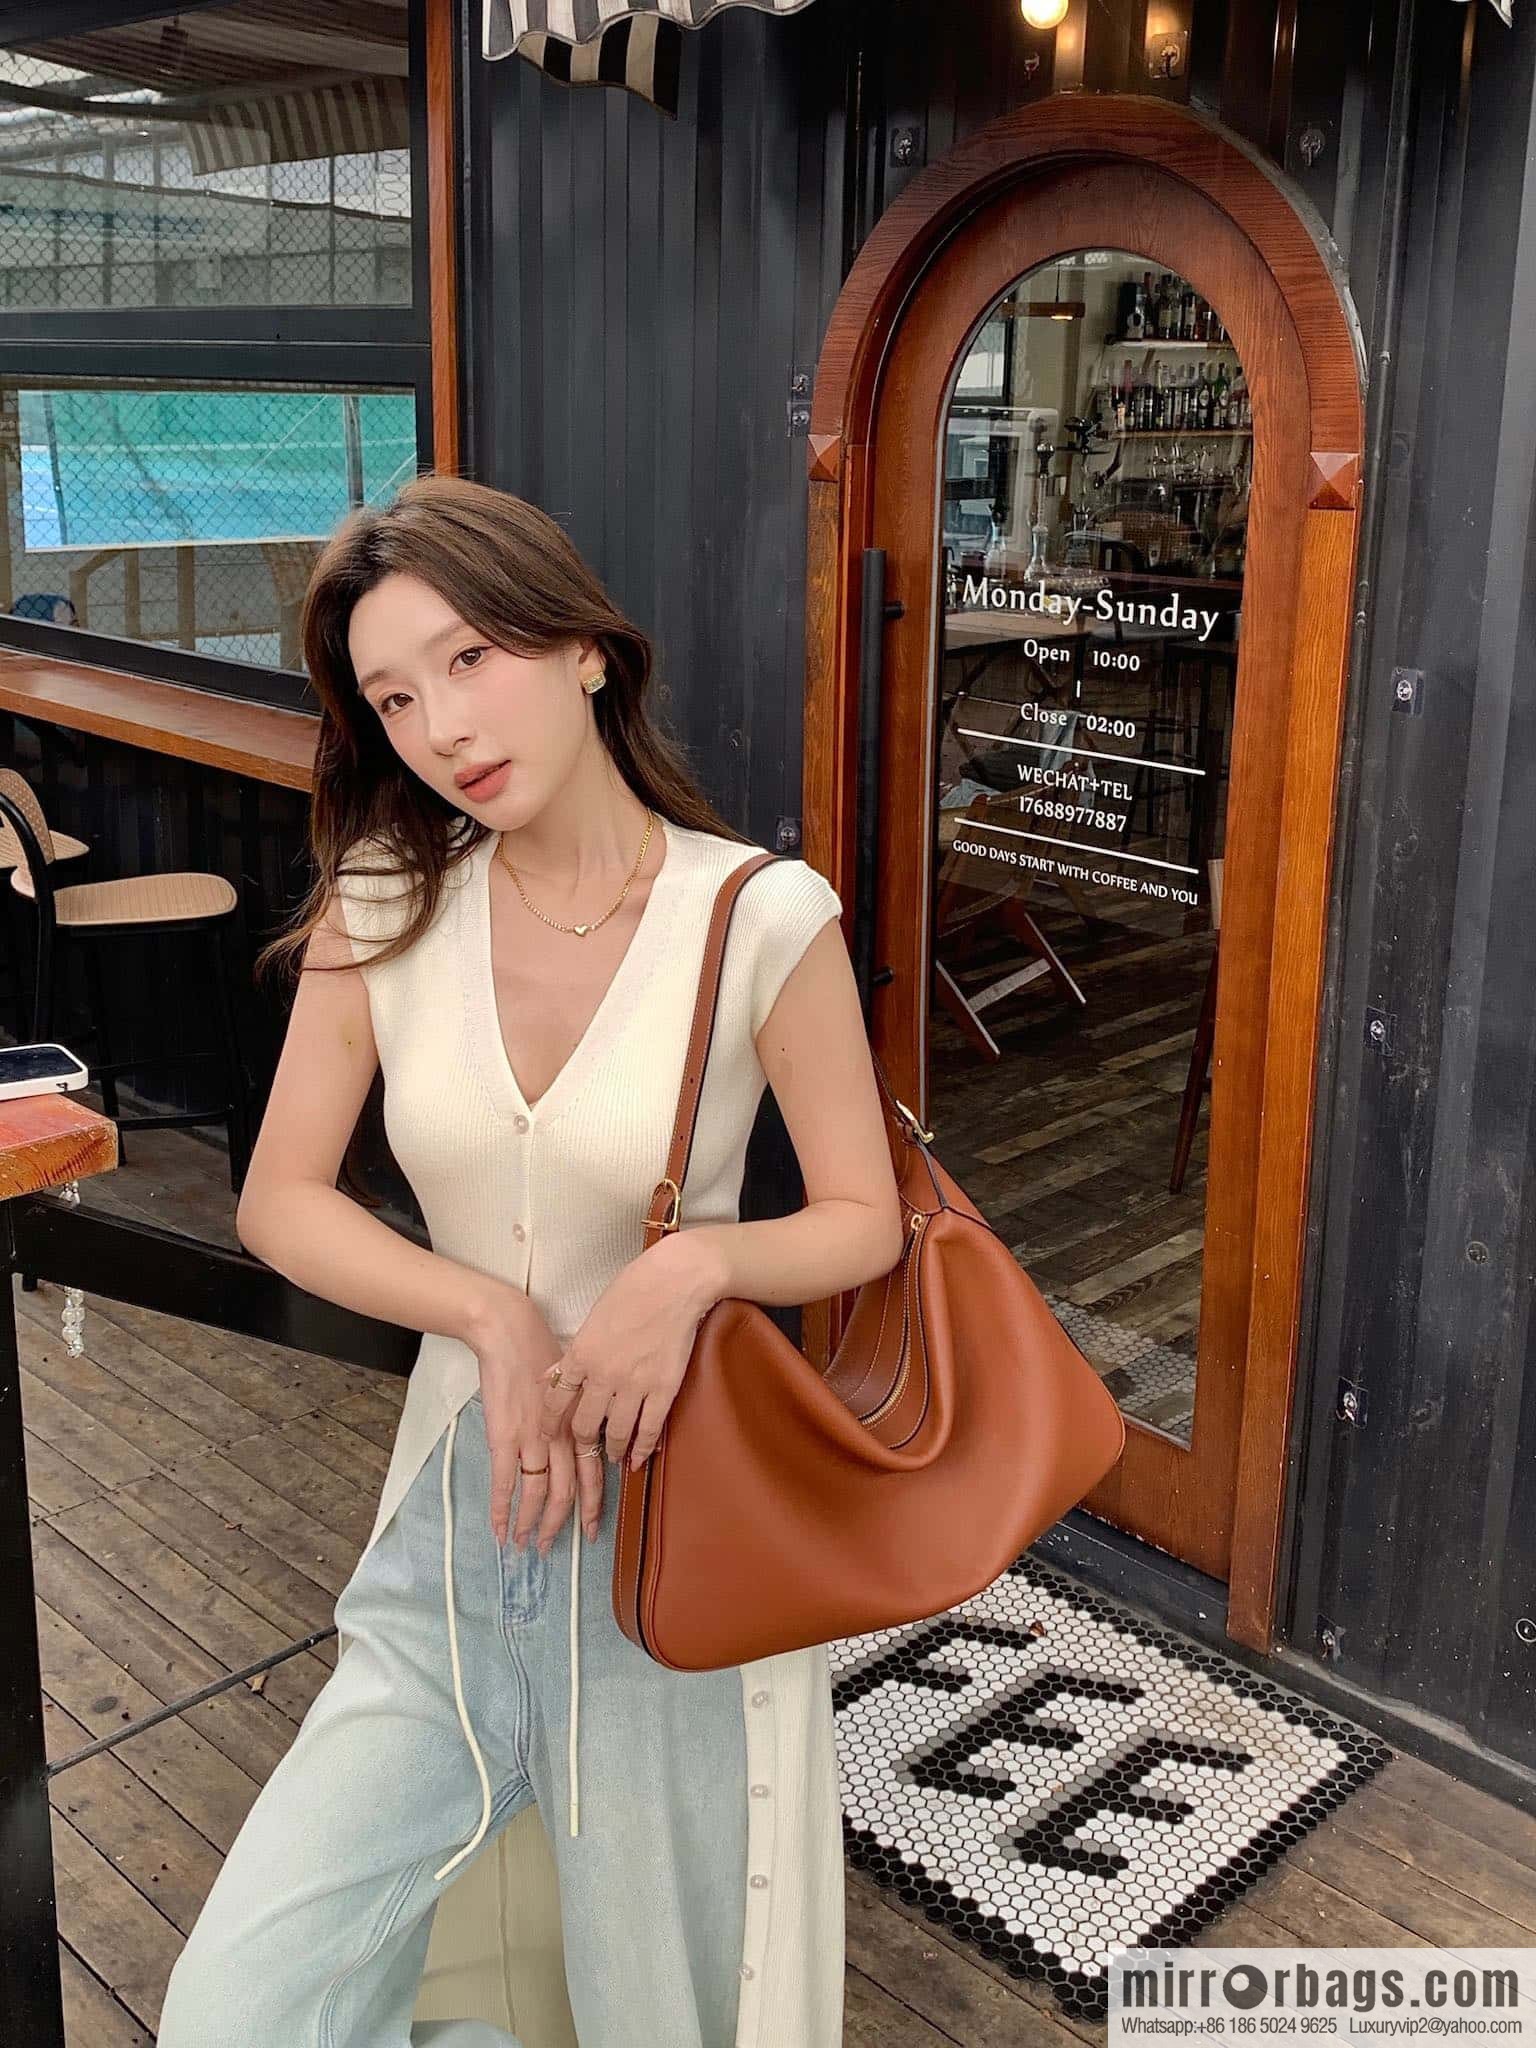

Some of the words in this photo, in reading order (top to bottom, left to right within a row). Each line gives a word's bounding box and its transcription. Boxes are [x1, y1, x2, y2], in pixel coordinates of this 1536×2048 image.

[962, 574, 1219, 641] Monday-Sunday
[1023, 638, 1071, 665] Open
[1092, 650, 1141, 672] 10:00
[1020, 703, 1068, 727] Close
[1085, 715, 1136, 739] 02:00
[1017, 764, 1133, 801] WECHAT+TEL
[1019, 796, 1127, 833] 17688977887
[952, 839, 987, 858] GOOD
[989, 848, 1018, 866] DAYS
[1018, 854, 1055, 874] START
[1056, 861, 1090, 882] WITH
[1092, 870, 1138, 893] COFFEE
[1140, 882, 1169, 900] AND
[1170, 887, 1199, 907] YOU
